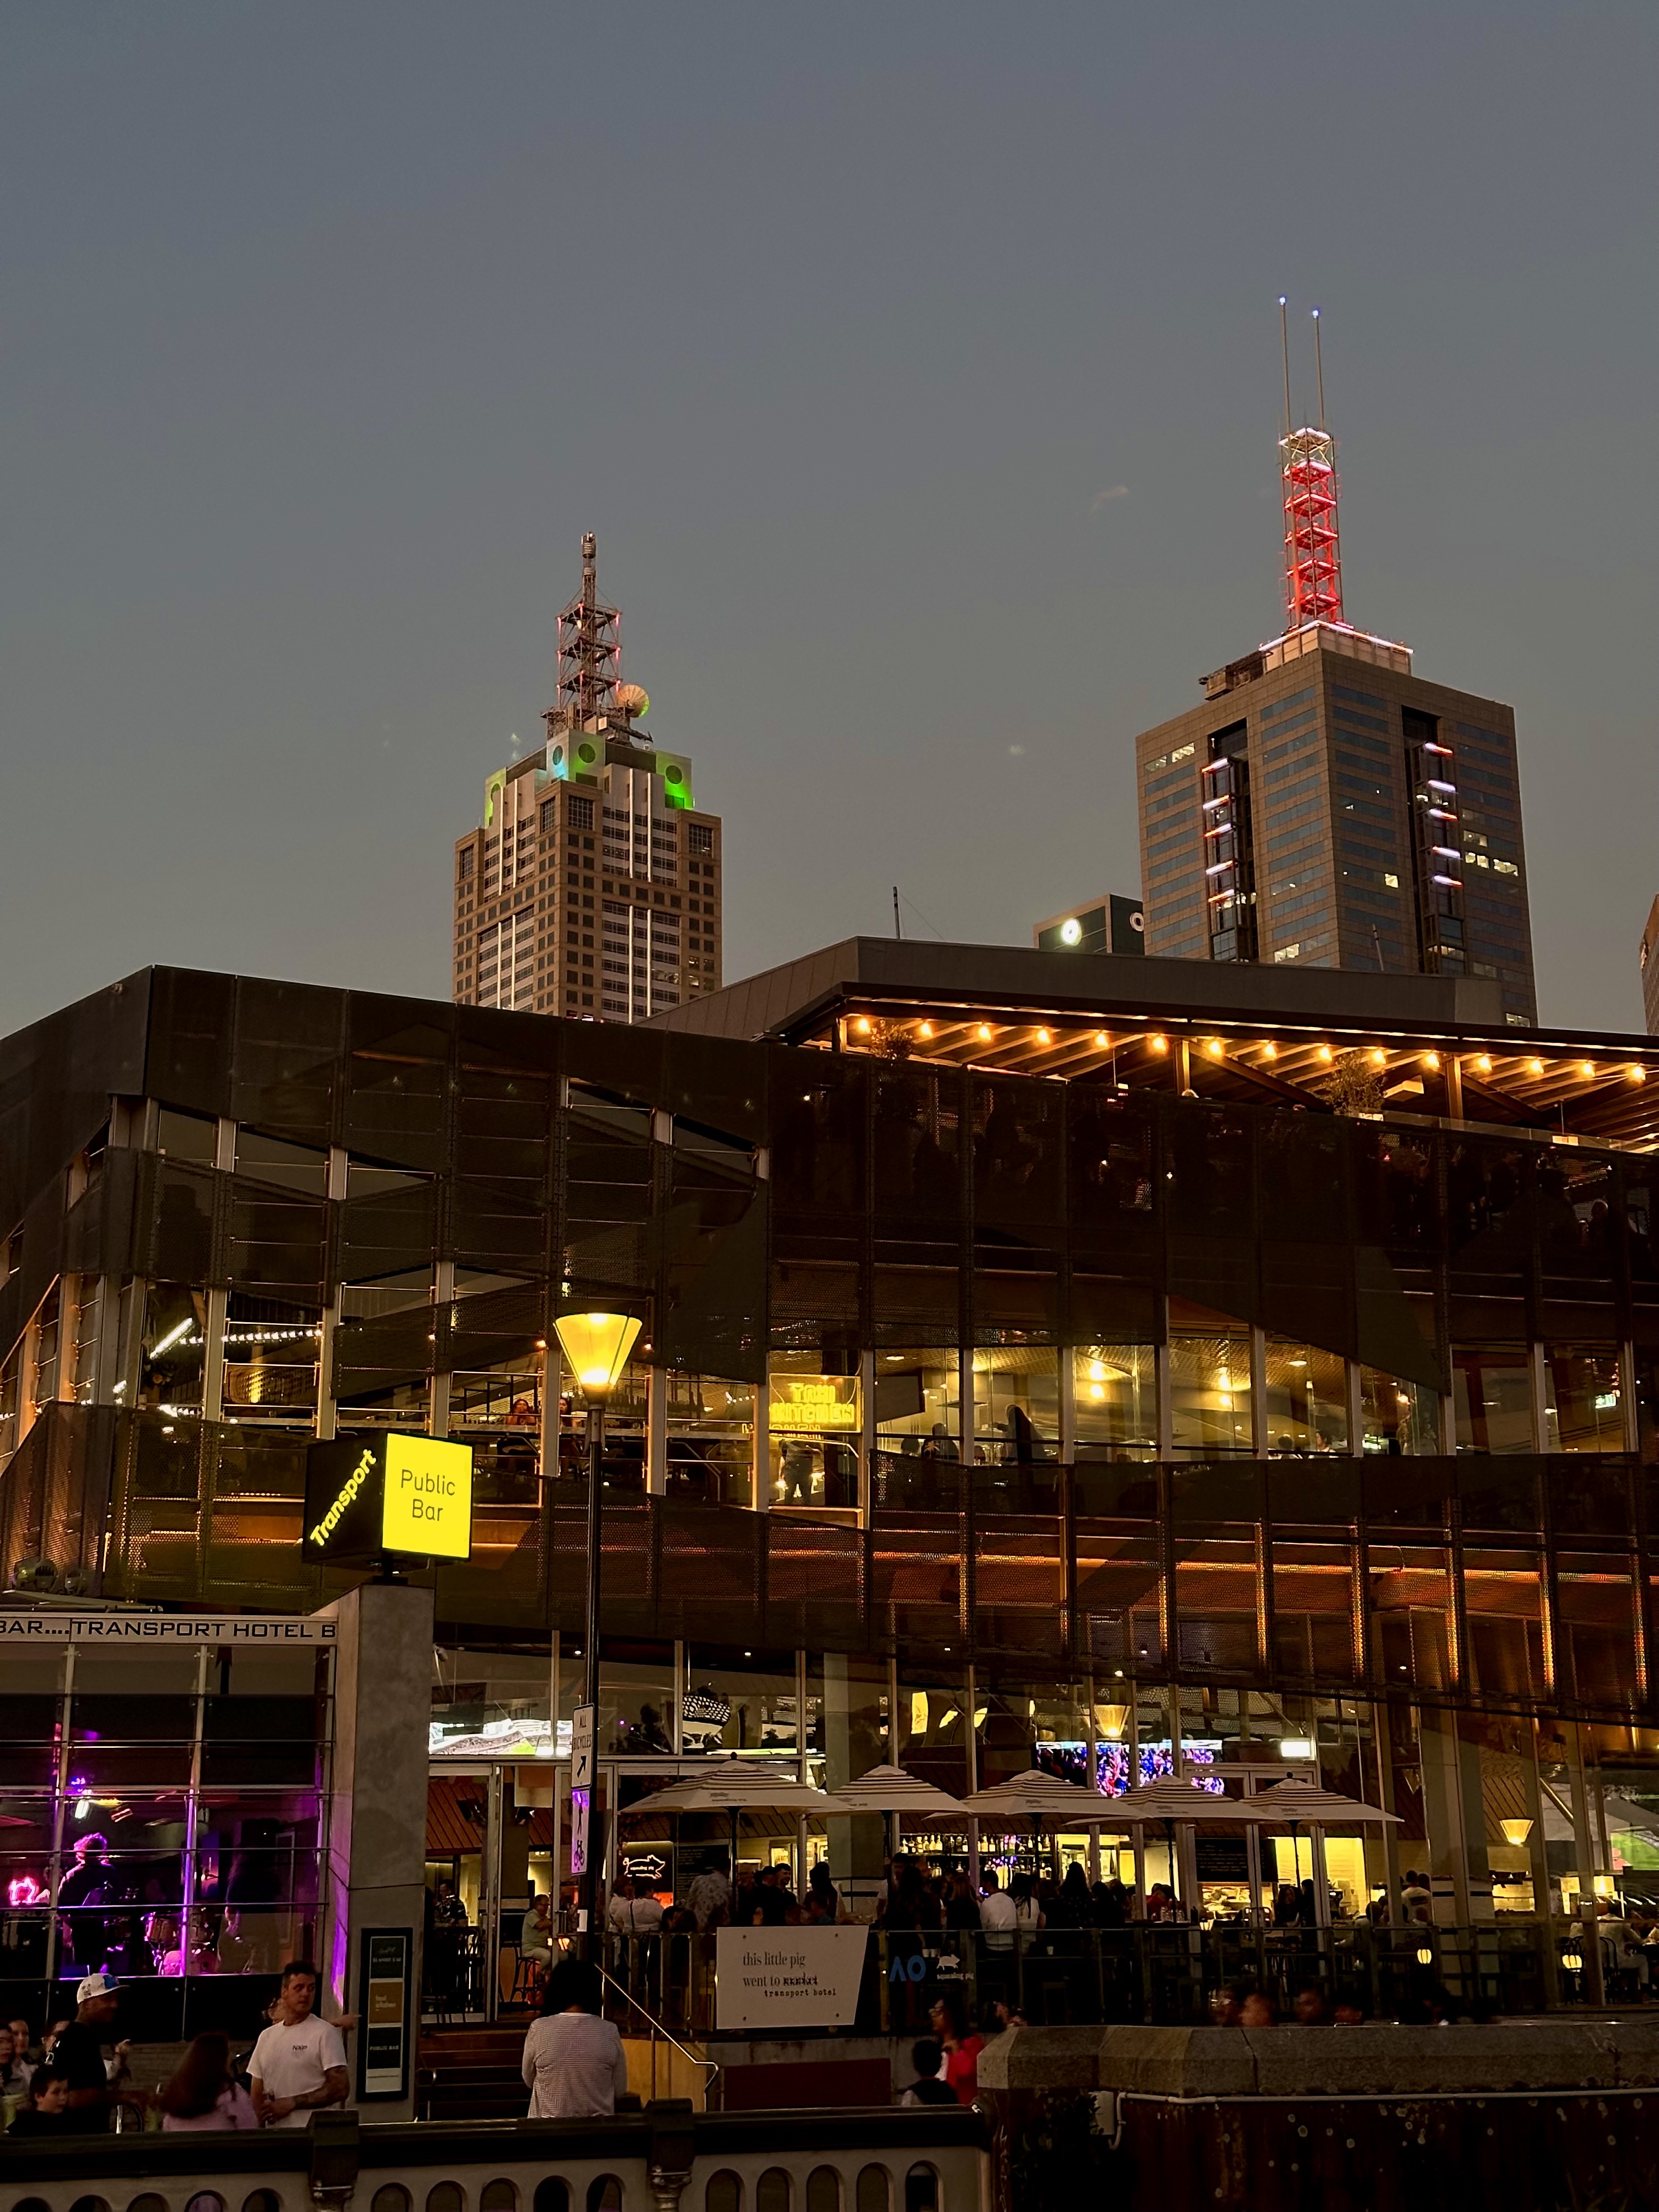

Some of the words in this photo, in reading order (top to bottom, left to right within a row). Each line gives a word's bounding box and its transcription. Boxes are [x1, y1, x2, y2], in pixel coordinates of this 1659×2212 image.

[770, 1403, 855, 1423] KITCHEN
[401, 1469, 455, 1496] Public
[310, 1449, 376, 1546] Transport
[412, 1499, 443, 1521] Bar
[72, 1621, 225, 1637] TRANSPORT
[234, 1623, 313, 1638] HOTEL
[321, 1624, 336, 1638] B
[573, 1734, 591, 1751] BICYCLES
[743, 1952, 762, 1966] this
[764, 1951, 787, 1965] little
[790, 1952, 806, 1969] pig
[743, 1975, 767, 1987] went
[770, 1975, 780, 1987] to
[764, 1988, 809, 1998] transport
